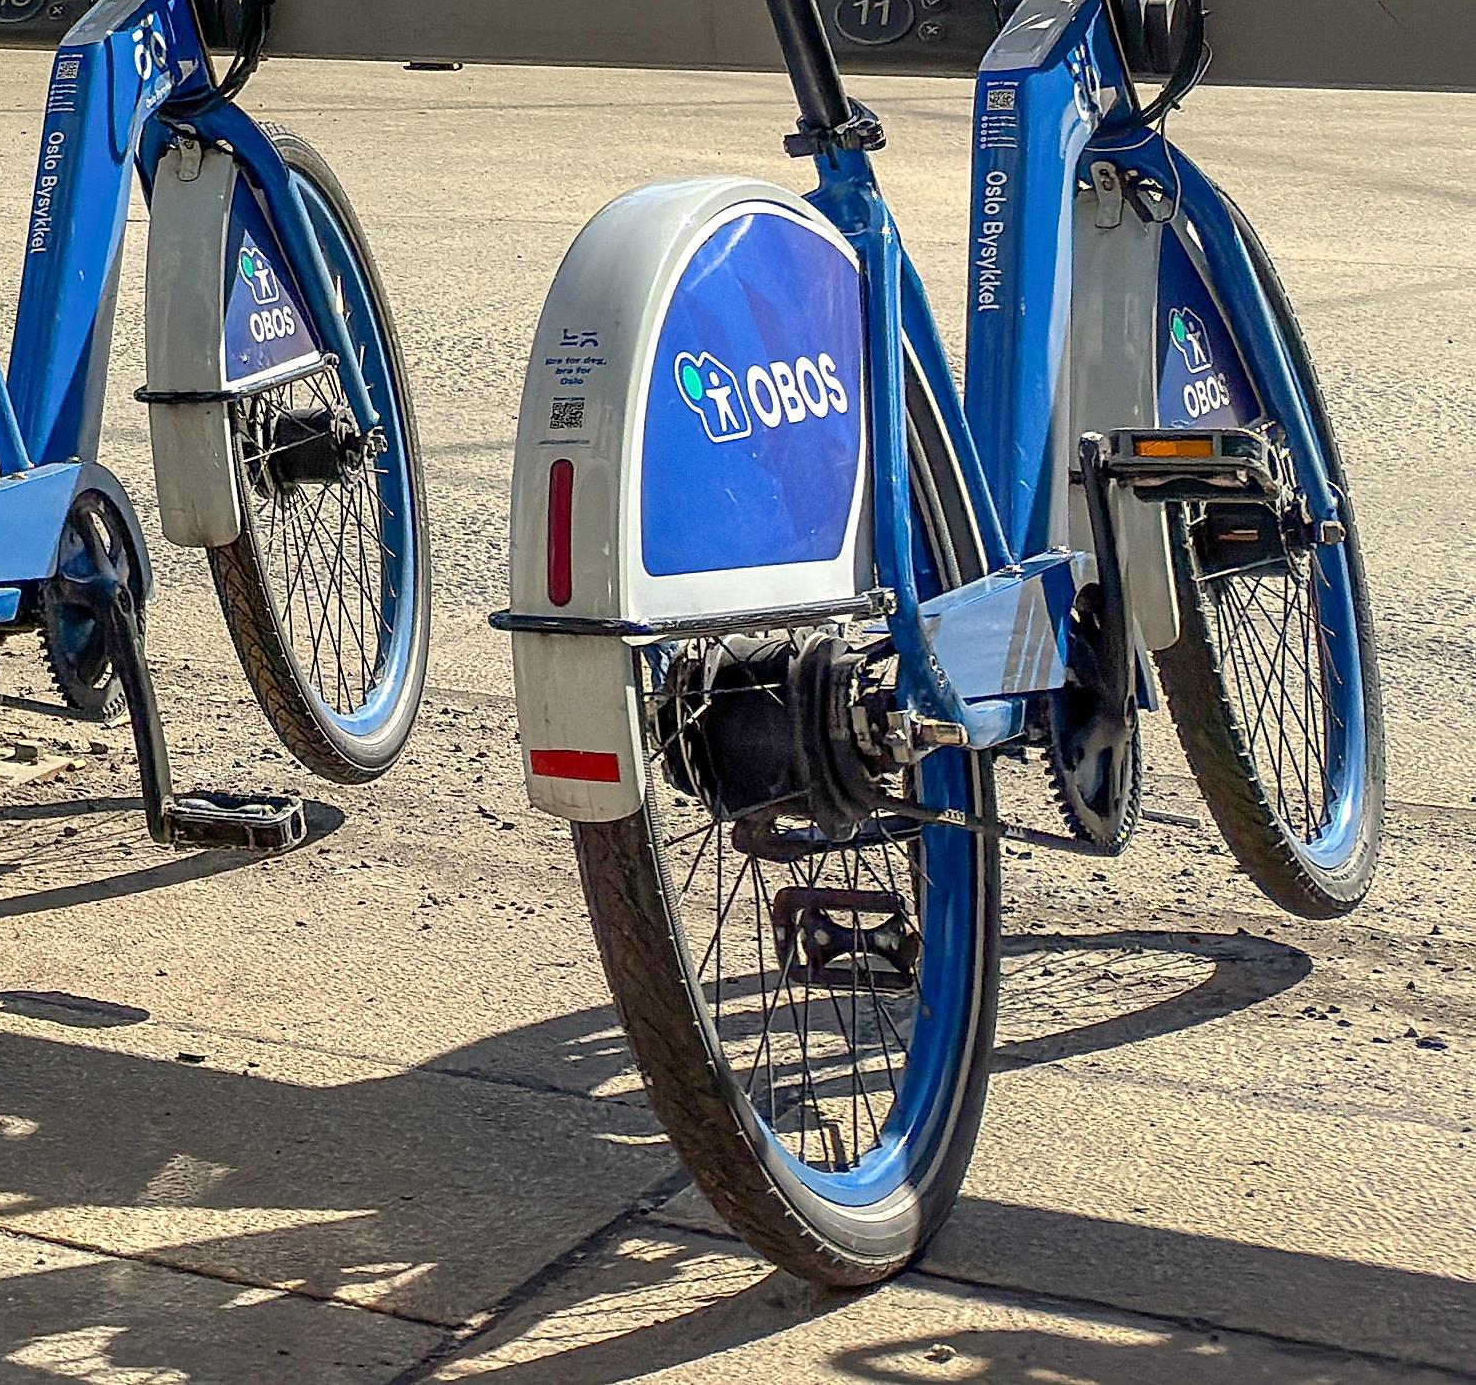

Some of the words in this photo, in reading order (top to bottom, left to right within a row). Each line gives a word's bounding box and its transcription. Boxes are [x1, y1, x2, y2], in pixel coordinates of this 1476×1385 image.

[44, 131, 65, 170] Oslo
[29, 175, 58, 254] Bysykkel
[983, 170, 1008, 215] Oslo
[975, 221, 1004, 312] Bysykkel
[249, 306, 296, 344] OBOS
[746, 352, 849, 428] OBOS
[1182, 373, 1231, 418] OBOS
